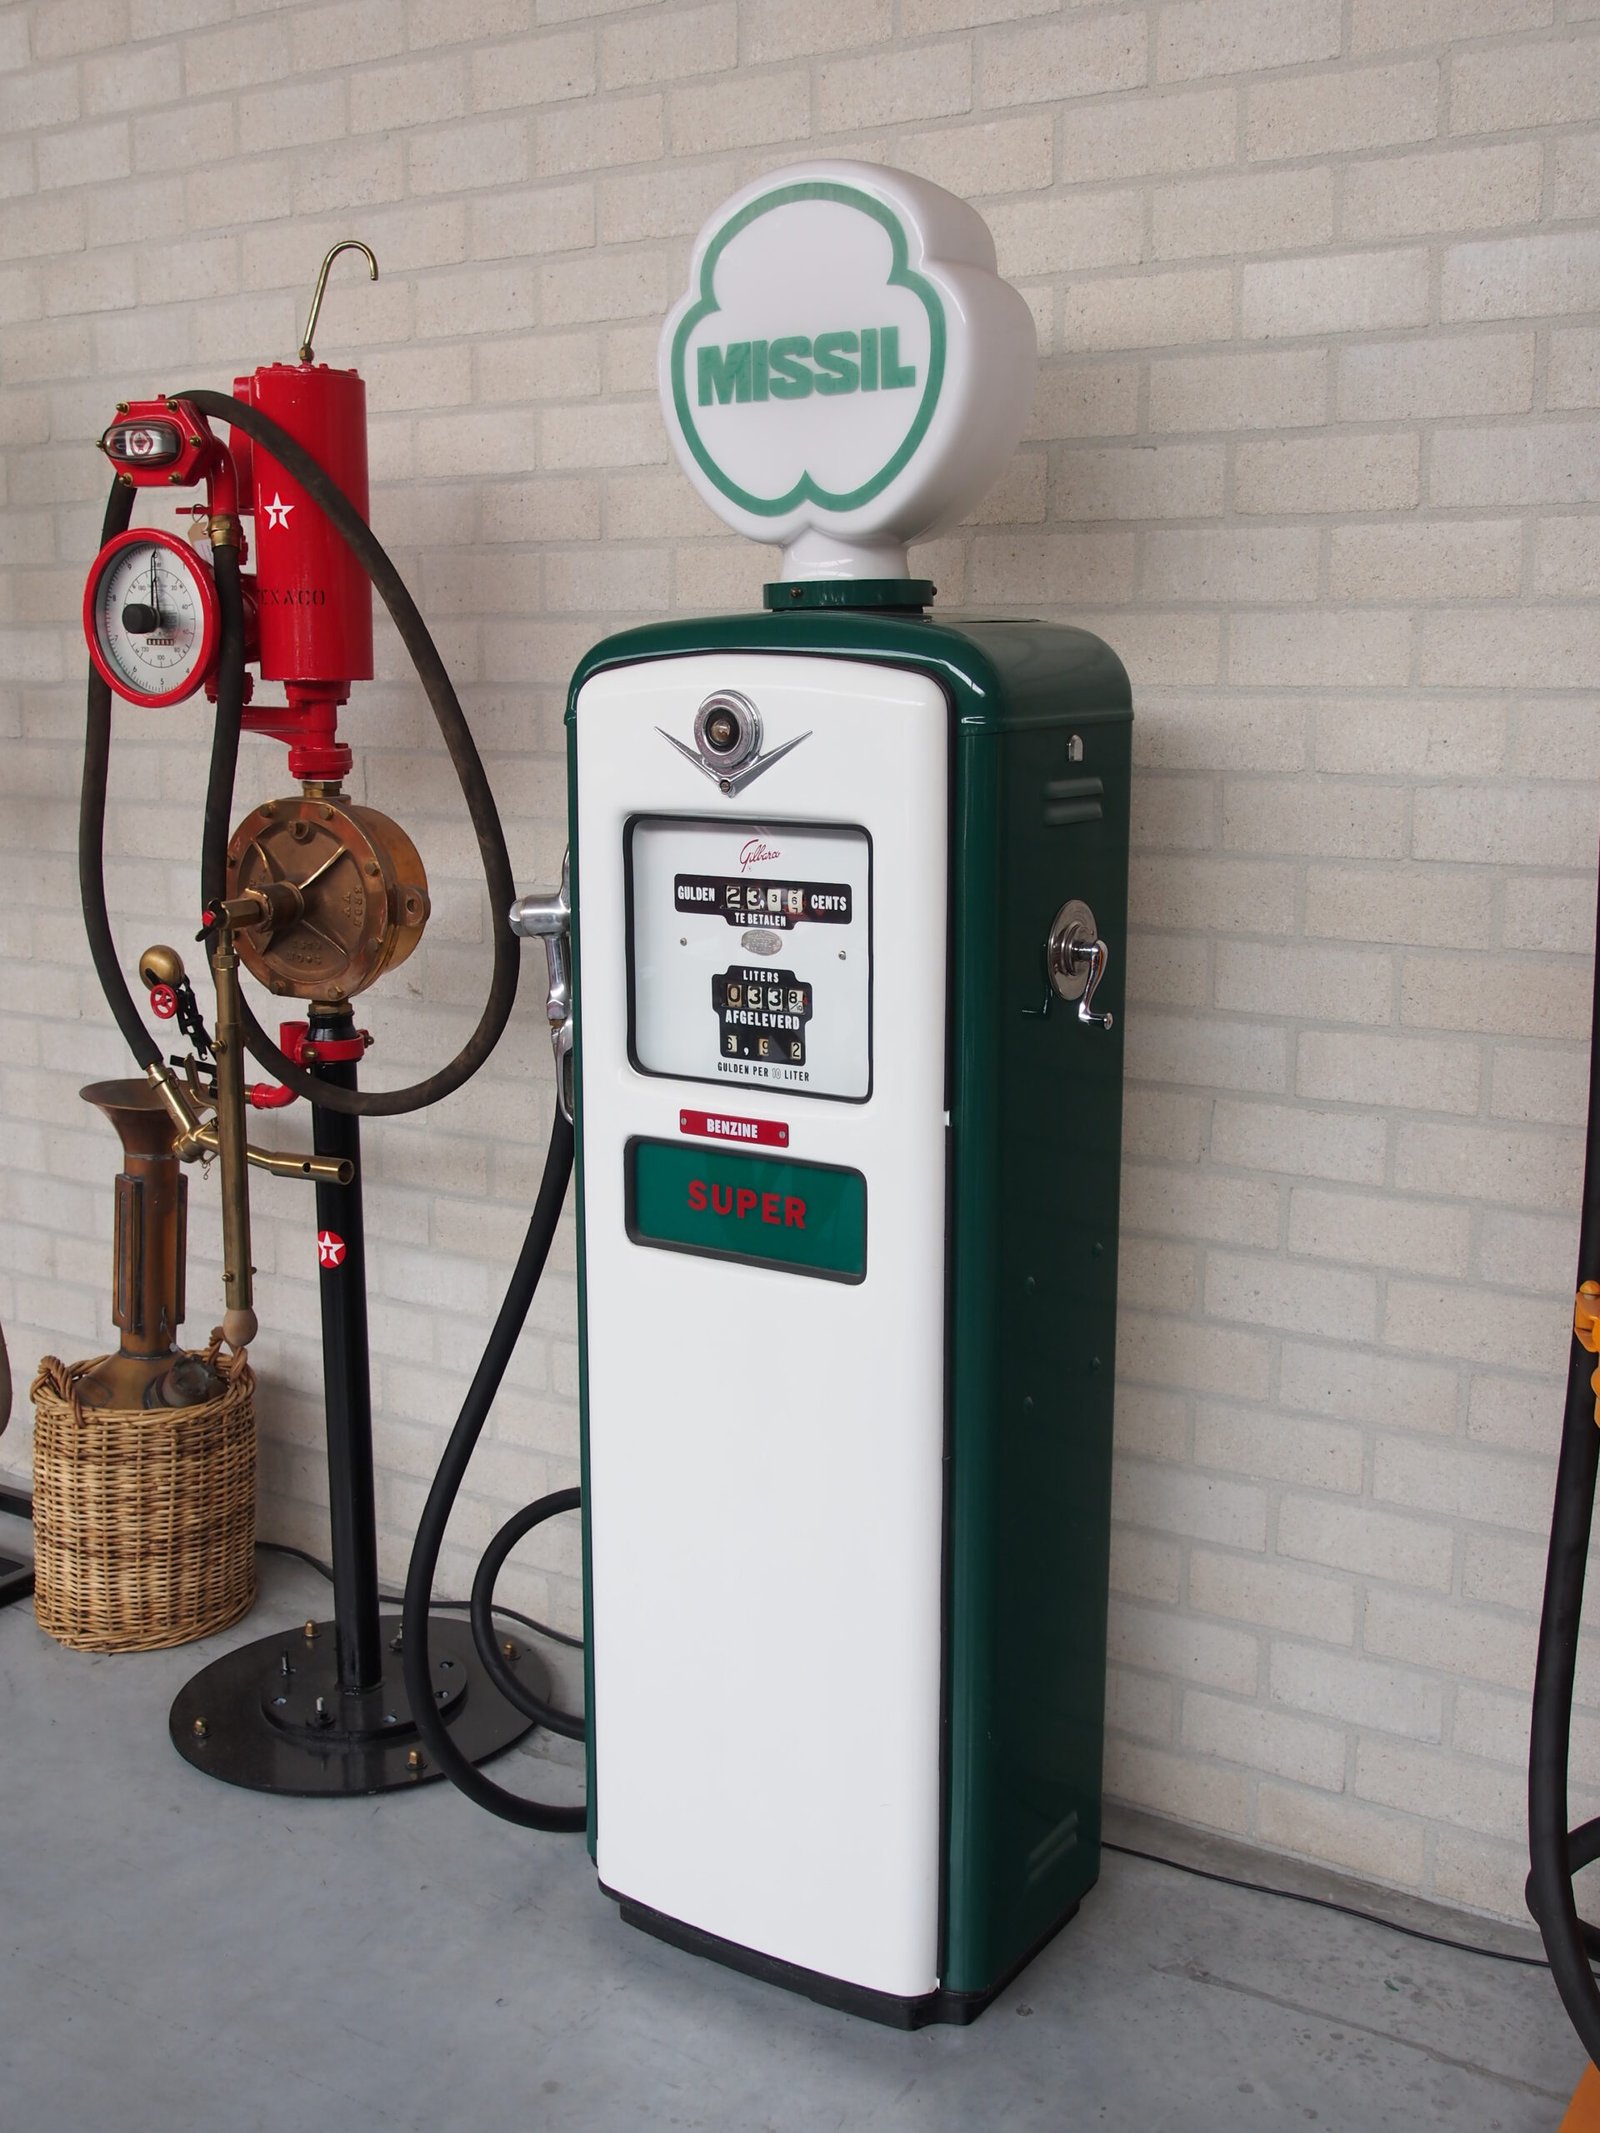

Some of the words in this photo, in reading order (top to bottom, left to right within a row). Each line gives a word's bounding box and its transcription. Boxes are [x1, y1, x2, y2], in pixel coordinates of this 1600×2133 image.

[697, 326, 916, 407] MISSIL
[677, 885, 716, 902] GULDEN
[811, 894, 847, 911] CENTS
[734, 912, 746, 924] TE
[748, 913, 786, 927] BETALEN
[743, 969, 779, 983] LITERS
[725, 1009, 800, 1030] AFGELEVERD
[717, 1061, 749, 1075] GULDEN
[752, 1065, 769, 1077] PER
[784, 1069, 809, 1081] LITER
[706, 1118, 758, 1139] BENZINE
[687, 1179, 806, 1229] SUPER
